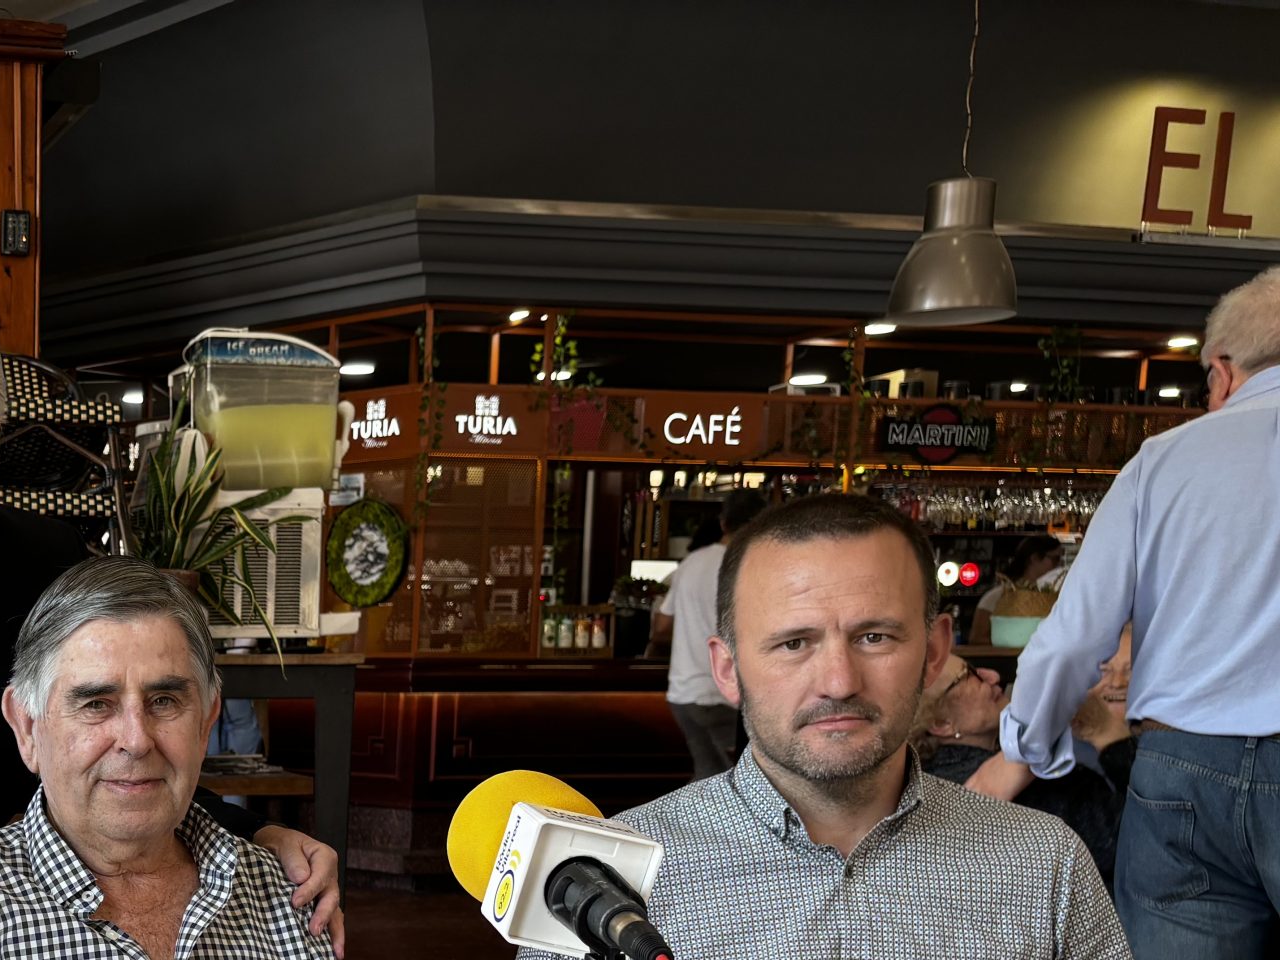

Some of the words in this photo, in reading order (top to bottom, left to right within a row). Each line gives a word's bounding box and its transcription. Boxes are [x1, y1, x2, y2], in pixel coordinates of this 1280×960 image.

[1141, 106, 1253, 230] EL
[350, 417, 401, 440] TURIA
[455, 414, 518, 436] TURIA
[663, 406, 742, 446] CAFÉ
[887, 421, 991, 451] MARTINI
